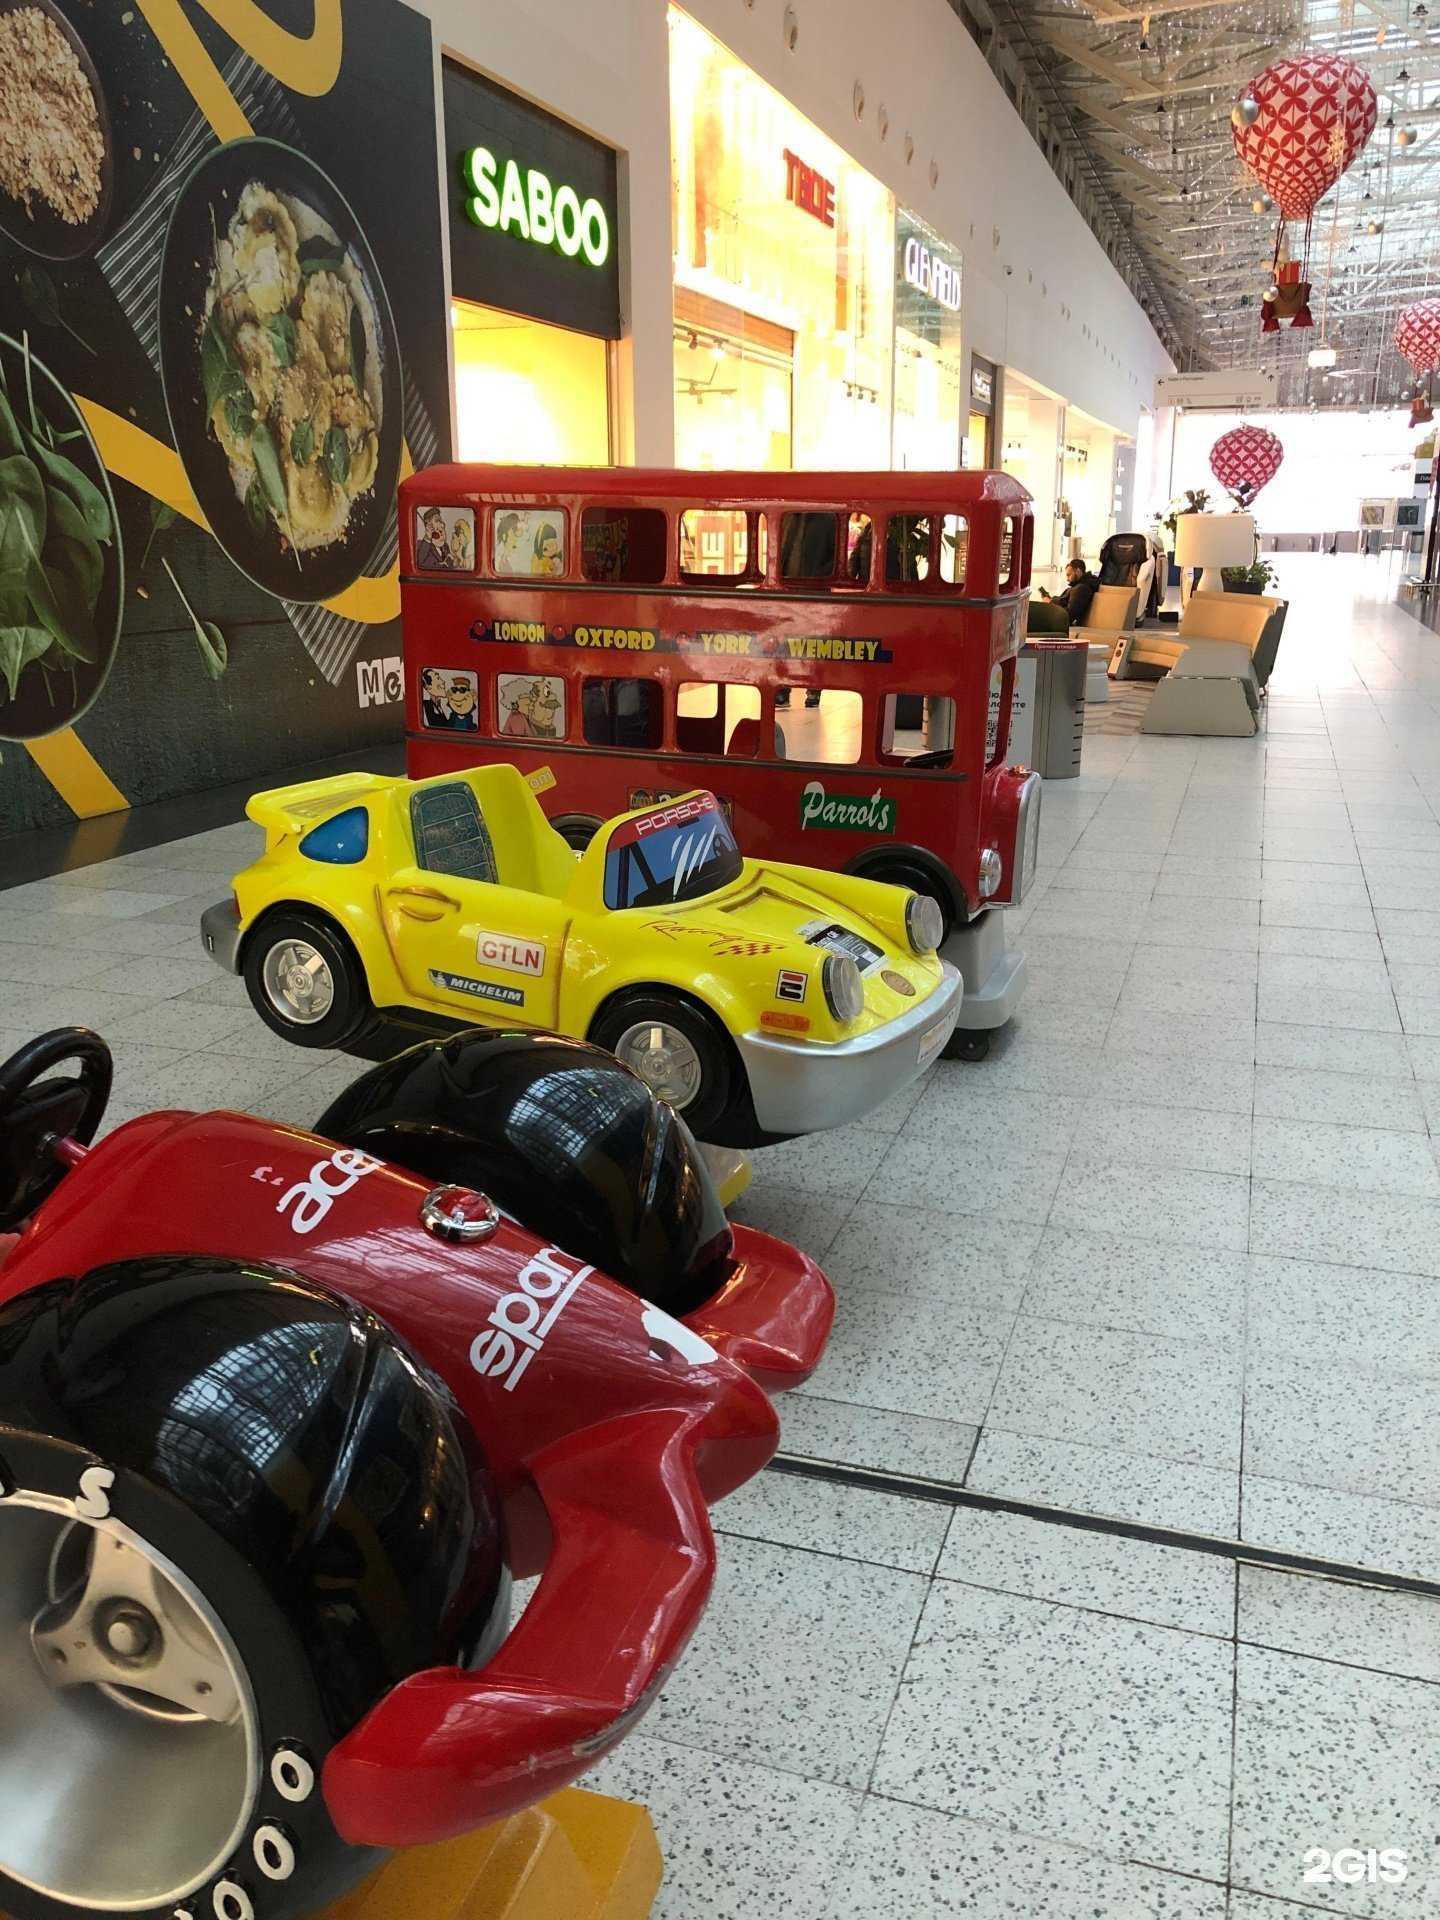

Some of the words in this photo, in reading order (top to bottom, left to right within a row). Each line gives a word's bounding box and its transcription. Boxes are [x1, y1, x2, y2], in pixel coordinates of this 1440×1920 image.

[466, 146, 609, 267] SABOO
[494, 621, 546, 643] LONDON
[574, 626, 656, 651] OXFORD
[700, 632, 753, 656] YORK
[786, 637, 879, 662] WEMBLEY
[634, 796, 715, 836] PORSCHE
[801, 780, 890, 831] Parrots
[482, 940, 540, 969] GTLN
[275, 1148, 388, 1235] ace
[470, 1244, 595, 1388] spar
